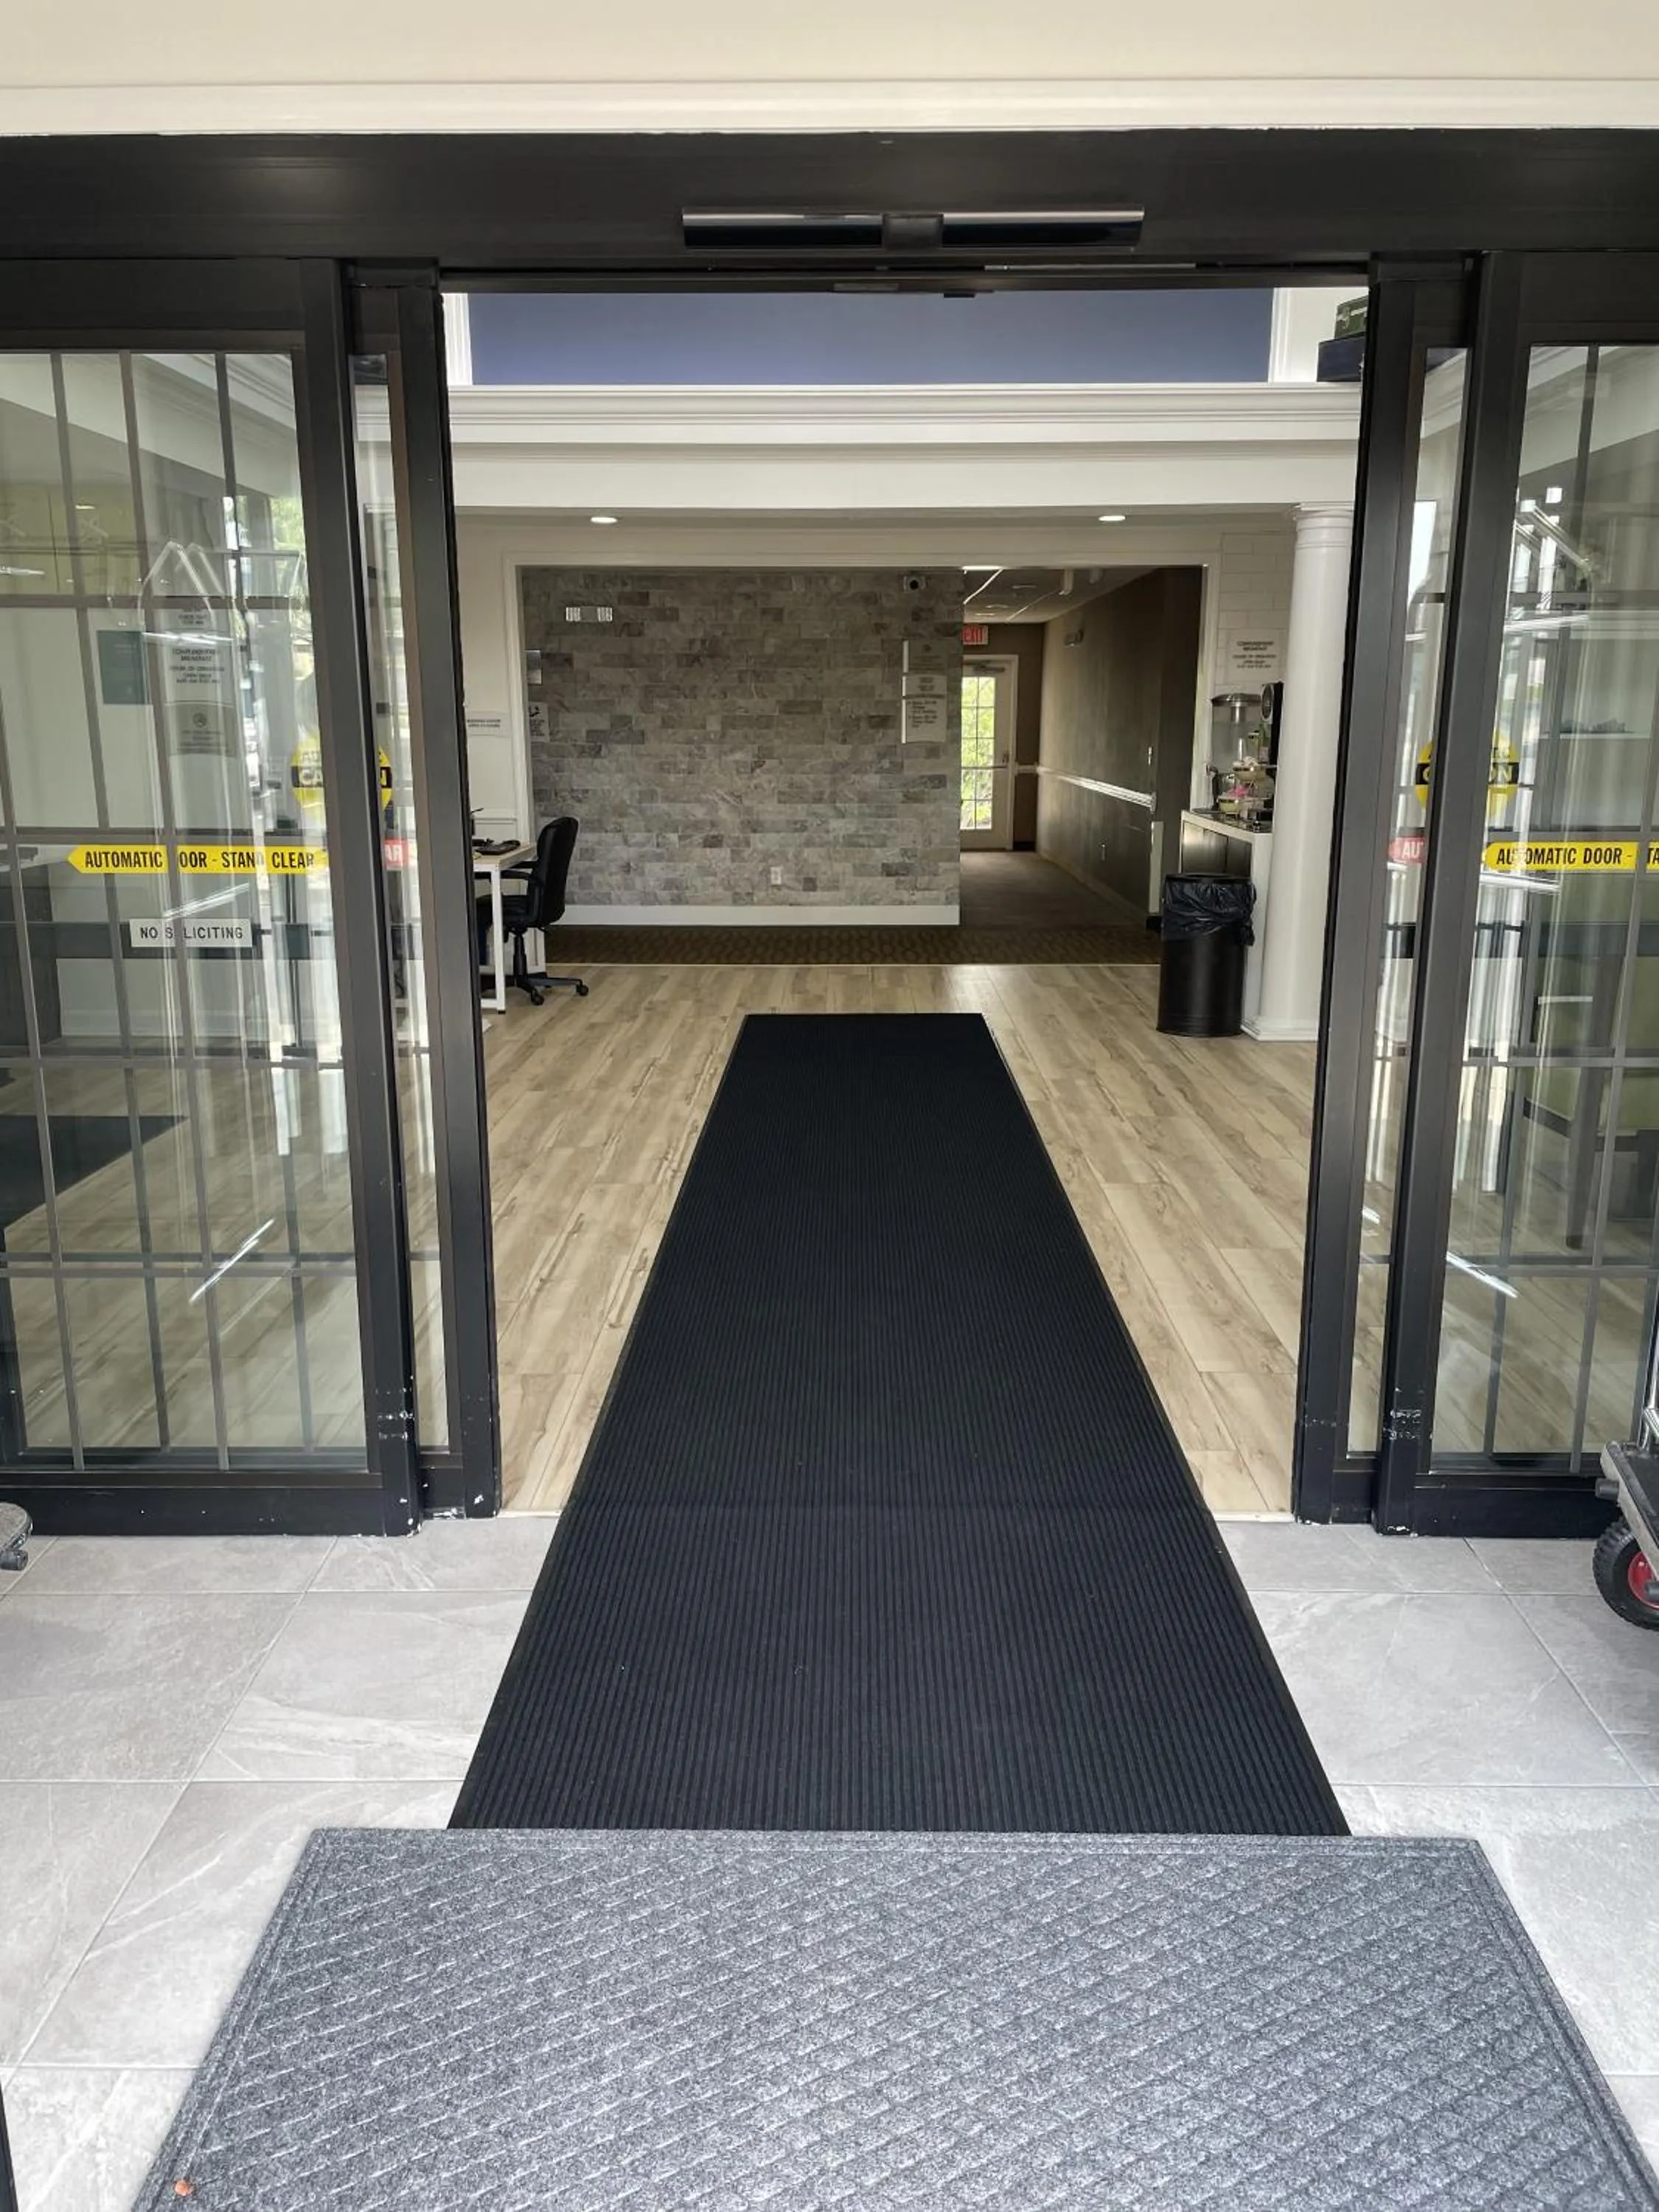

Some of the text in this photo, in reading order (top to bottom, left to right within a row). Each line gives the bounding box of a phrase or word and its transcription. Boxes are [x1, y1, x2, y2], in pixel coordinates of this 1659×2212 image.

[85, 850, 163, 869] AUTOMATIC
[178, 851, 207, 869] OOR
[272, 851, 315, 869] CLEAR
[1496, 847, 1577, 865] AUOMATIC
[1583, 847, 1622, 865] DOOR
[139, 926, 243, 940] NO SLICITING
